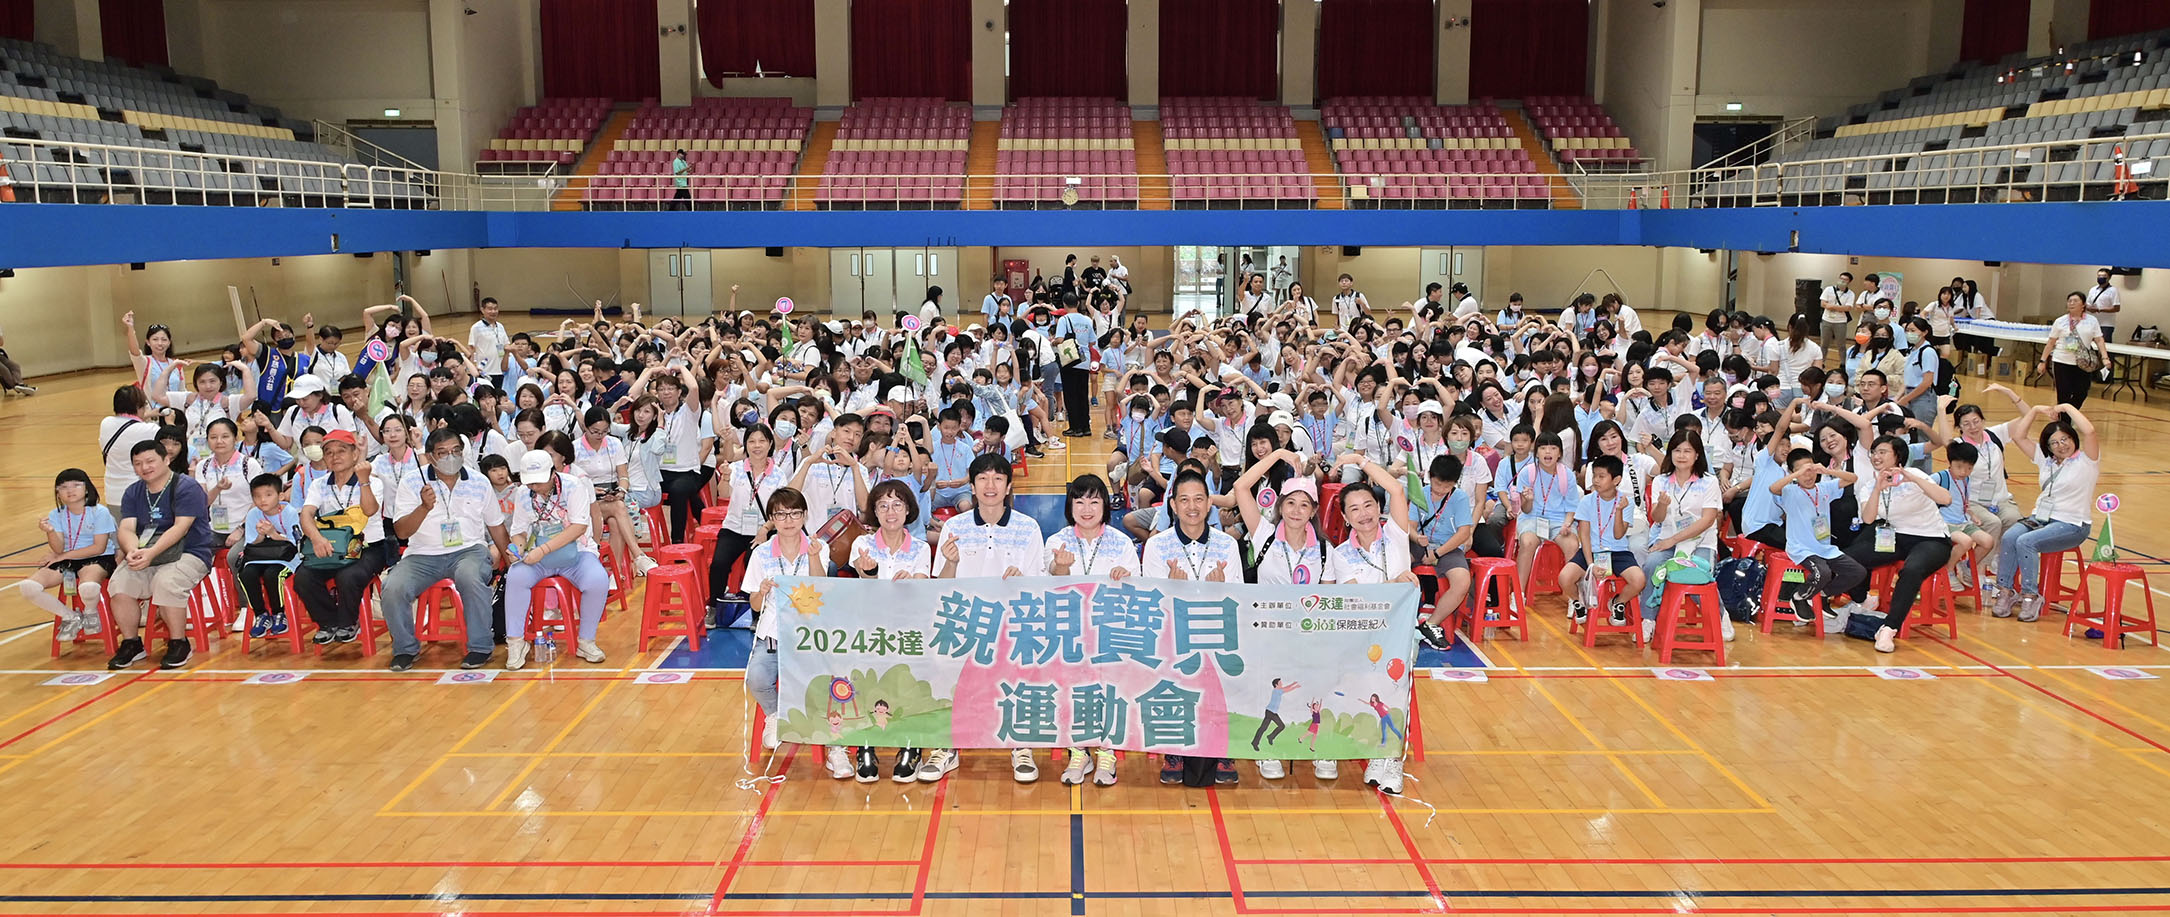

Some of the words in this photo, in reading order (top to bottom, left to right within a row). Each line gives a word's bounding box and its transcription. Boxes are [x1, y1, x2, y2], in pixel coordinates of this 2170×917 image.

[780, 300, 788, 309] 7
[907, 317, 916, 328] 6
[373, 343, 383, 356] 8
[1262, 489, 1271, 505] 5
[1296, 567, 1305, 584] 2
[1319, 597, 1343, 610] 永達
[796, 626, 924, 656] 2024永達
[928, 583, 1245, 677] 親親寶貝
[997, 679, 1201, 747] 運動會
